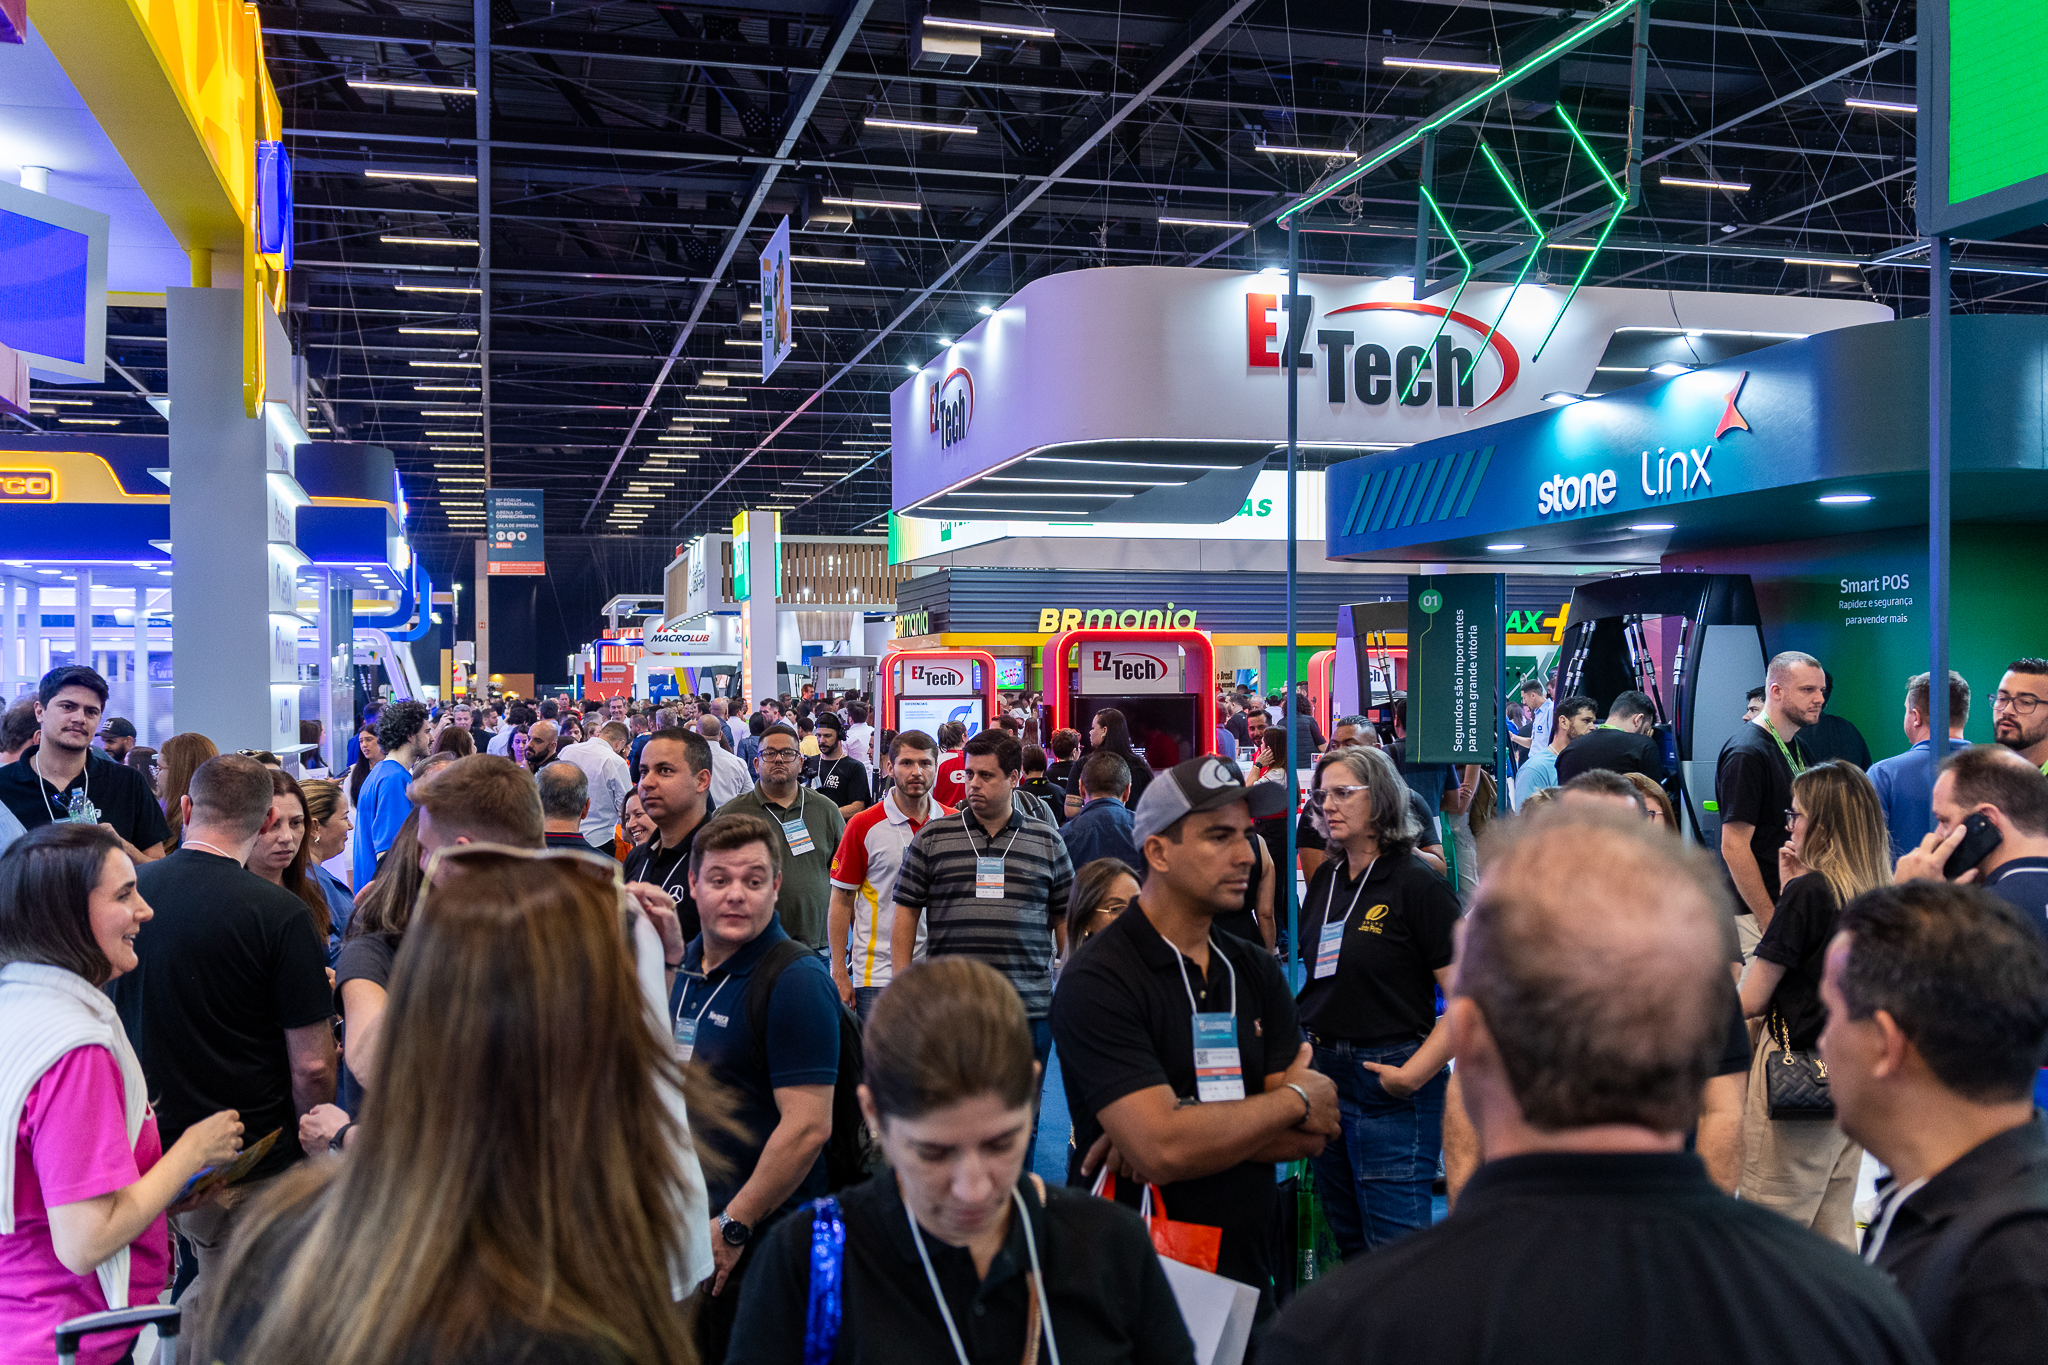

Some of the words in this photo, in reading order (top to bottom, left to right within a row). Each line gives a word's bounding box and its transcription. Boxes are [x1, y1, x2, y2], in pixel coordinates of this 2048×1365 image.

[1246, 293, 1314, 368] EZ
[1317, 329, 1474, 407] Tech
[930, 381, 940, 434] EZ
[940, 388, 967, 450] Tech
[0, 477, 50, 495] CO
[1538, 469, 1617, 514] stone
[1840, 578, 1879, 594] Smart
[1882, 574, 1909, 590] POS
[1423, 596, 1438, 606] 01
[1839, 599, 1867, 610] Rapidez
[1874, 597, 1913, 608] segurança
[895, 604, 928, 639] BRmania
[1038, 602, 1197, 633] BRmania
[1845, 616, 1862, 626] para
[1862, 615, 1888, 624] vender
[1889, 613, 1908, 623] mais
[650, 634, 710, 642] MACROLUB
[1454, 609, 1466, 676] importantes
[1467, 625, 1478, 660] vitória
[911, 666, 925, 679] EZ
[925, 672, 956, 686] Tech
[1093, 651, 1112, 671] EZ
[1112, 660, 1156, 680] Tech
[1369, 669, 1381, 683] ch
[1453, 677, 1464, 697] são
[1467, 661, 1479, 700] grande
[1453, 699, 1465, 752] Segundos
[1469, 702, 1478, 725] uma
[1468, 727, 1479, 752] para
